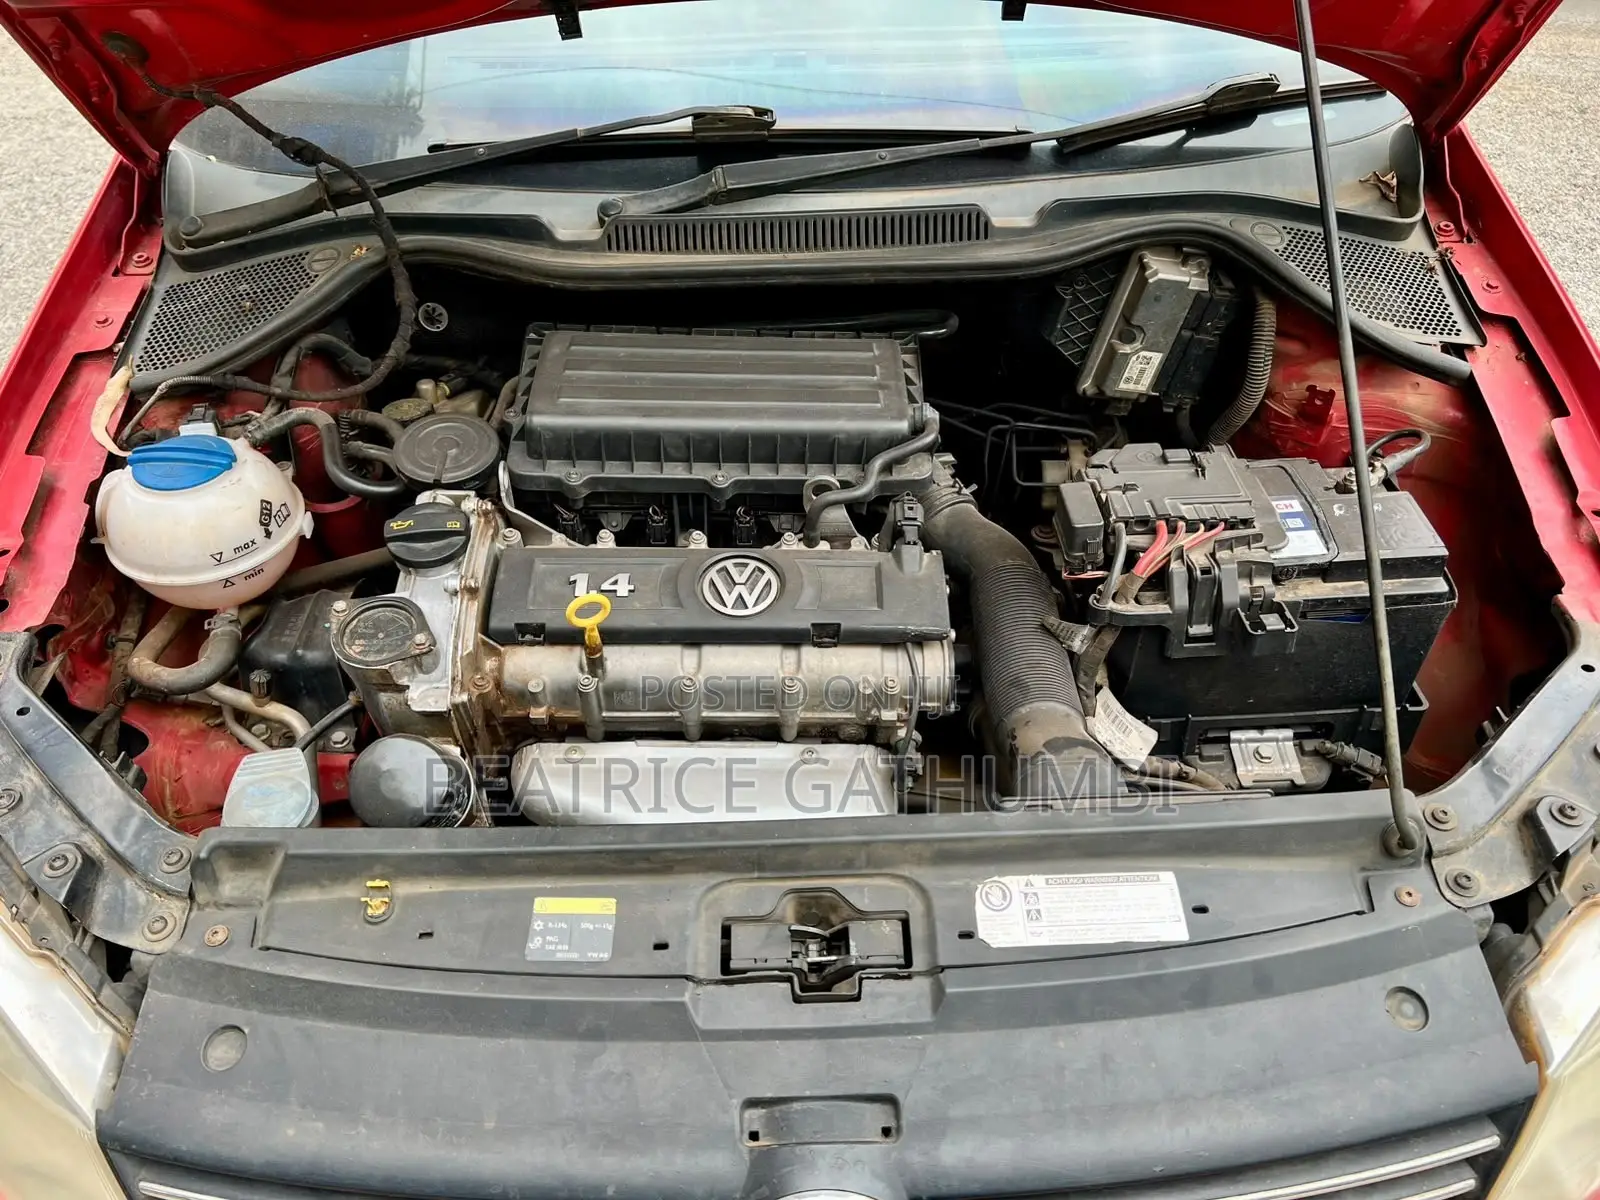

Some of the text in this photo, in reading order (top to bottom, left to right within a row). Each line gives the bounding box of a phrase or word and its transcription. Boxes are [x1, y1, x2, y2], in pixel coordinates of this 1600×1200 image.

[261, 501, 272, 524] G12
[233, 538, 257, 555] max
[243, 568, 265, 581] min
[568, 572, 635, 597] 1.4
